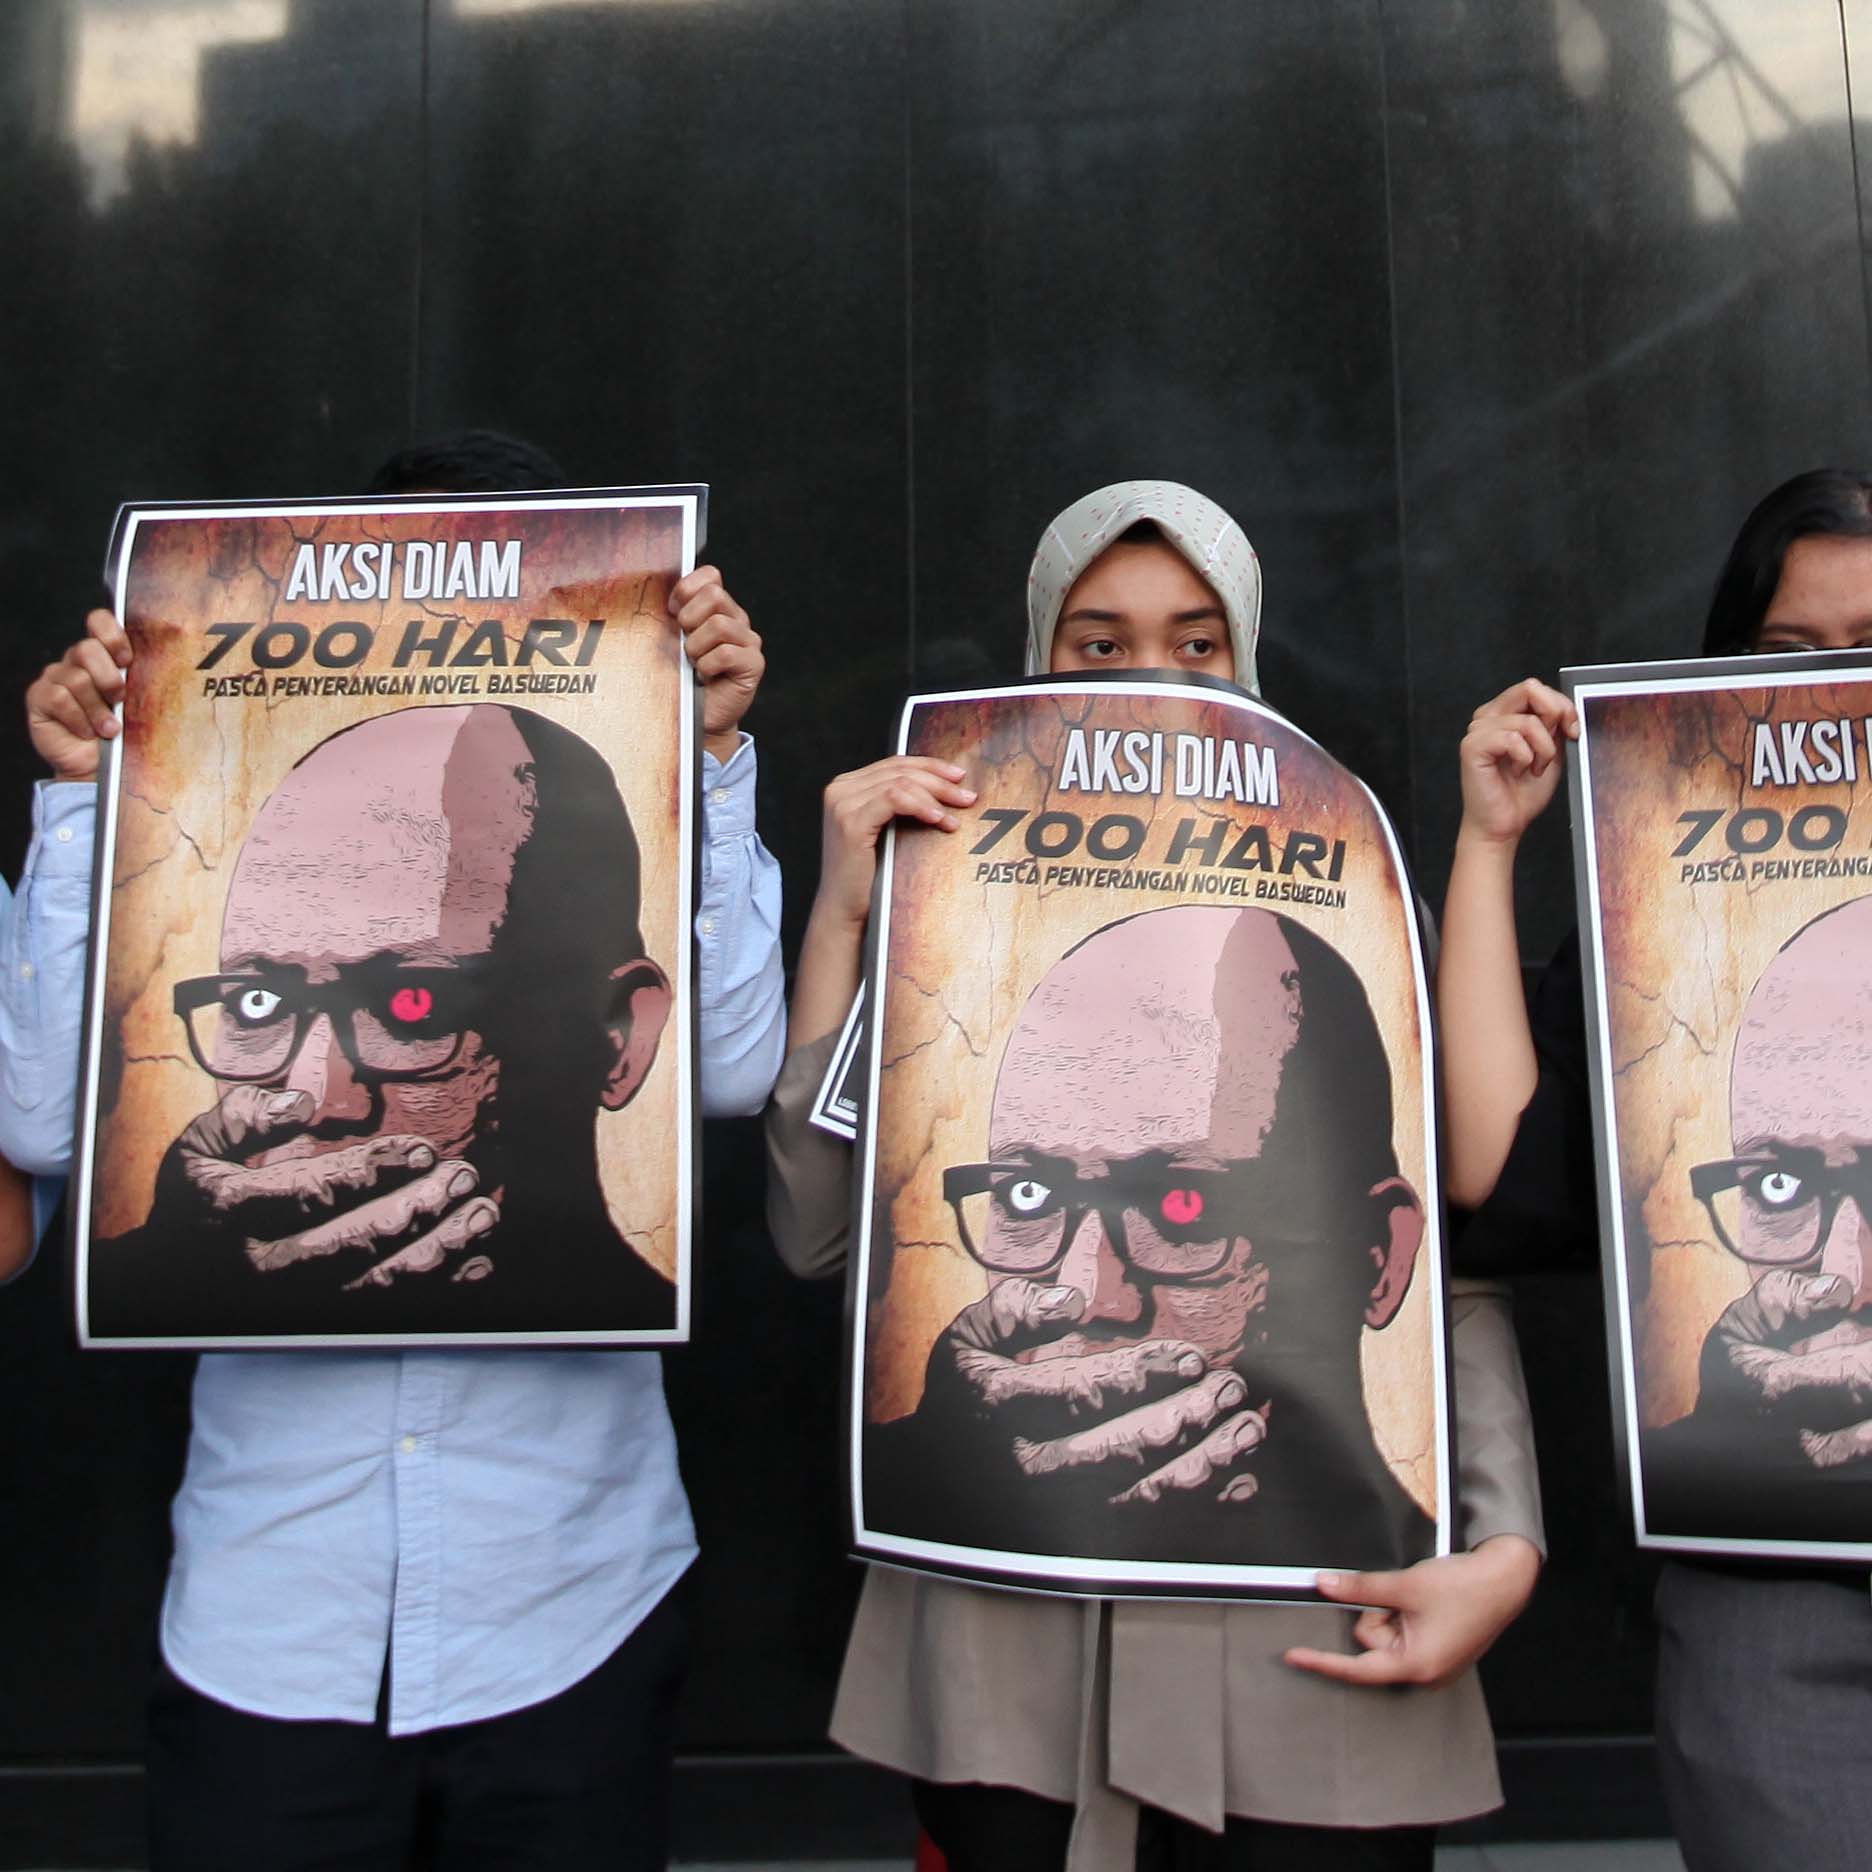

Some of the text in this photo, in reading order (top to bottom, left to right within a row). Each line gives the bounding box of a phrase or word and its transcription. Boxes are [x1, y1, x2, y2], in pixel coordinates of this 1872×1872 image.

[285, 539, 522, 603] AKSI DIAM
[196, 619, 607, 671] 700 HARI
[202, 673, 597, 698] PASCA PENYERANGAN NOVEL BASWEDAN
[1058, 728, 1281, 808] AKSI DIAM
[1751, 719, 1856, 788] AKSI
[968, 809, 1347, 883] 700 HARI
[1669, 805, 1850, 858] 700
[974, 862, 1347, 910] PASCA PENYERANGAN NOVEL BASWEDAN
[1680, 858, 1746, 883] PASCA
